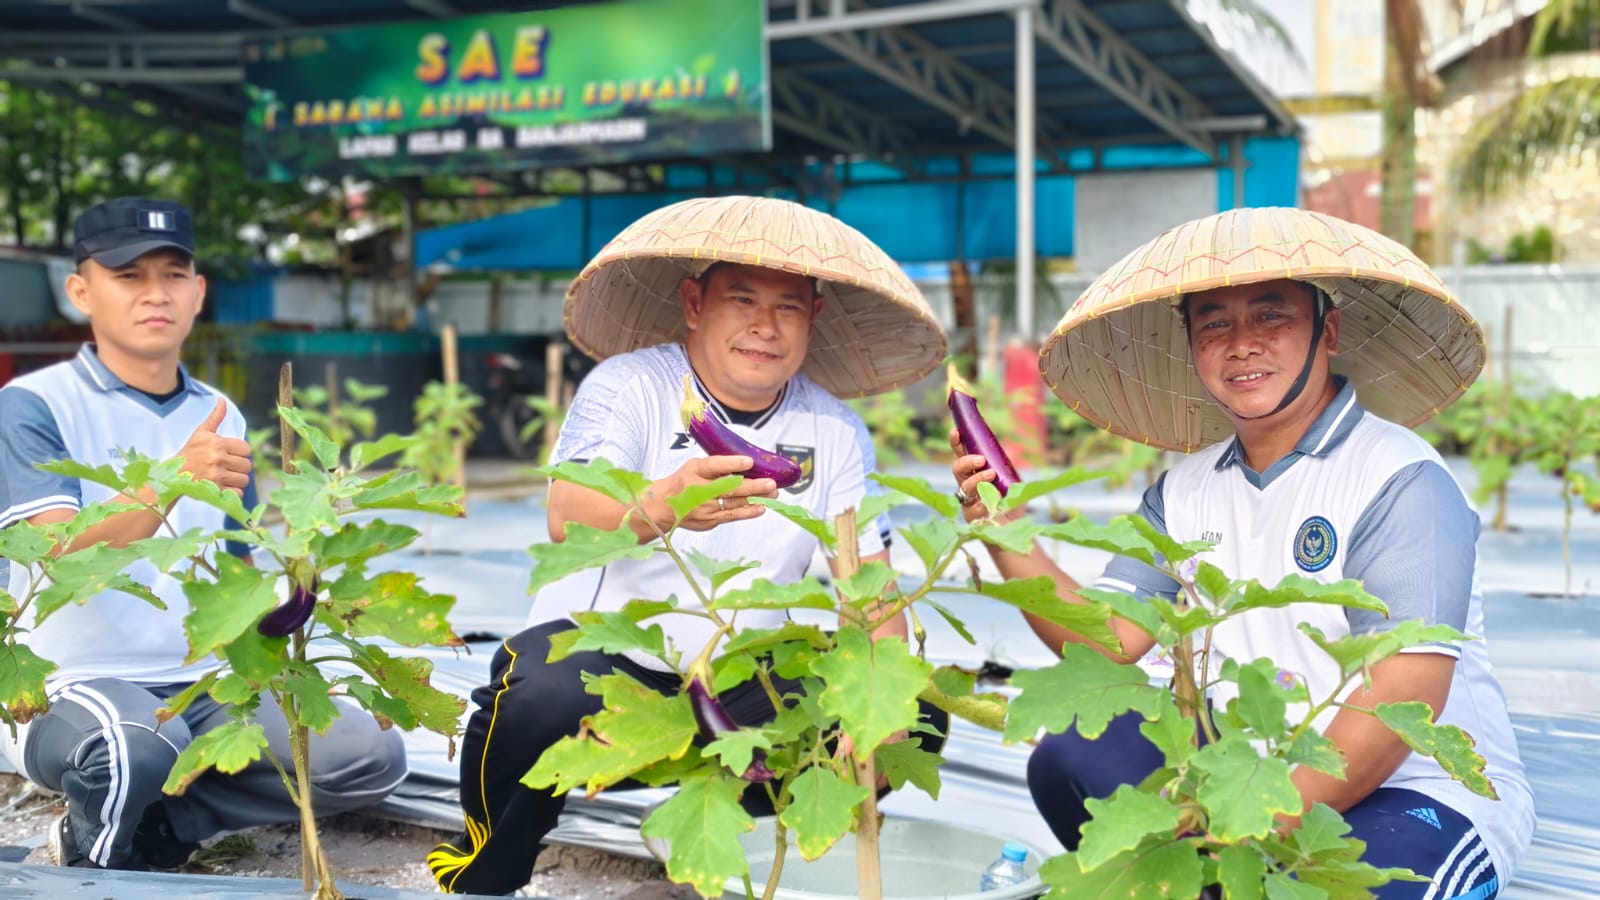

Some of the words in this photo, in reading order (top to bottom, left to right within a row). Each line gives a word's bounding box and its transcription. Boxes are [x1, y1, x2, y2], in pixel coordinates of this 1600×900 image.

[416, 27, 546, 84] SAE
[294, 98, 403, 126] SARANA
[420, 86, 563, 117] ASIMILASI
[583, 74, 706, 105] EDUKASI
